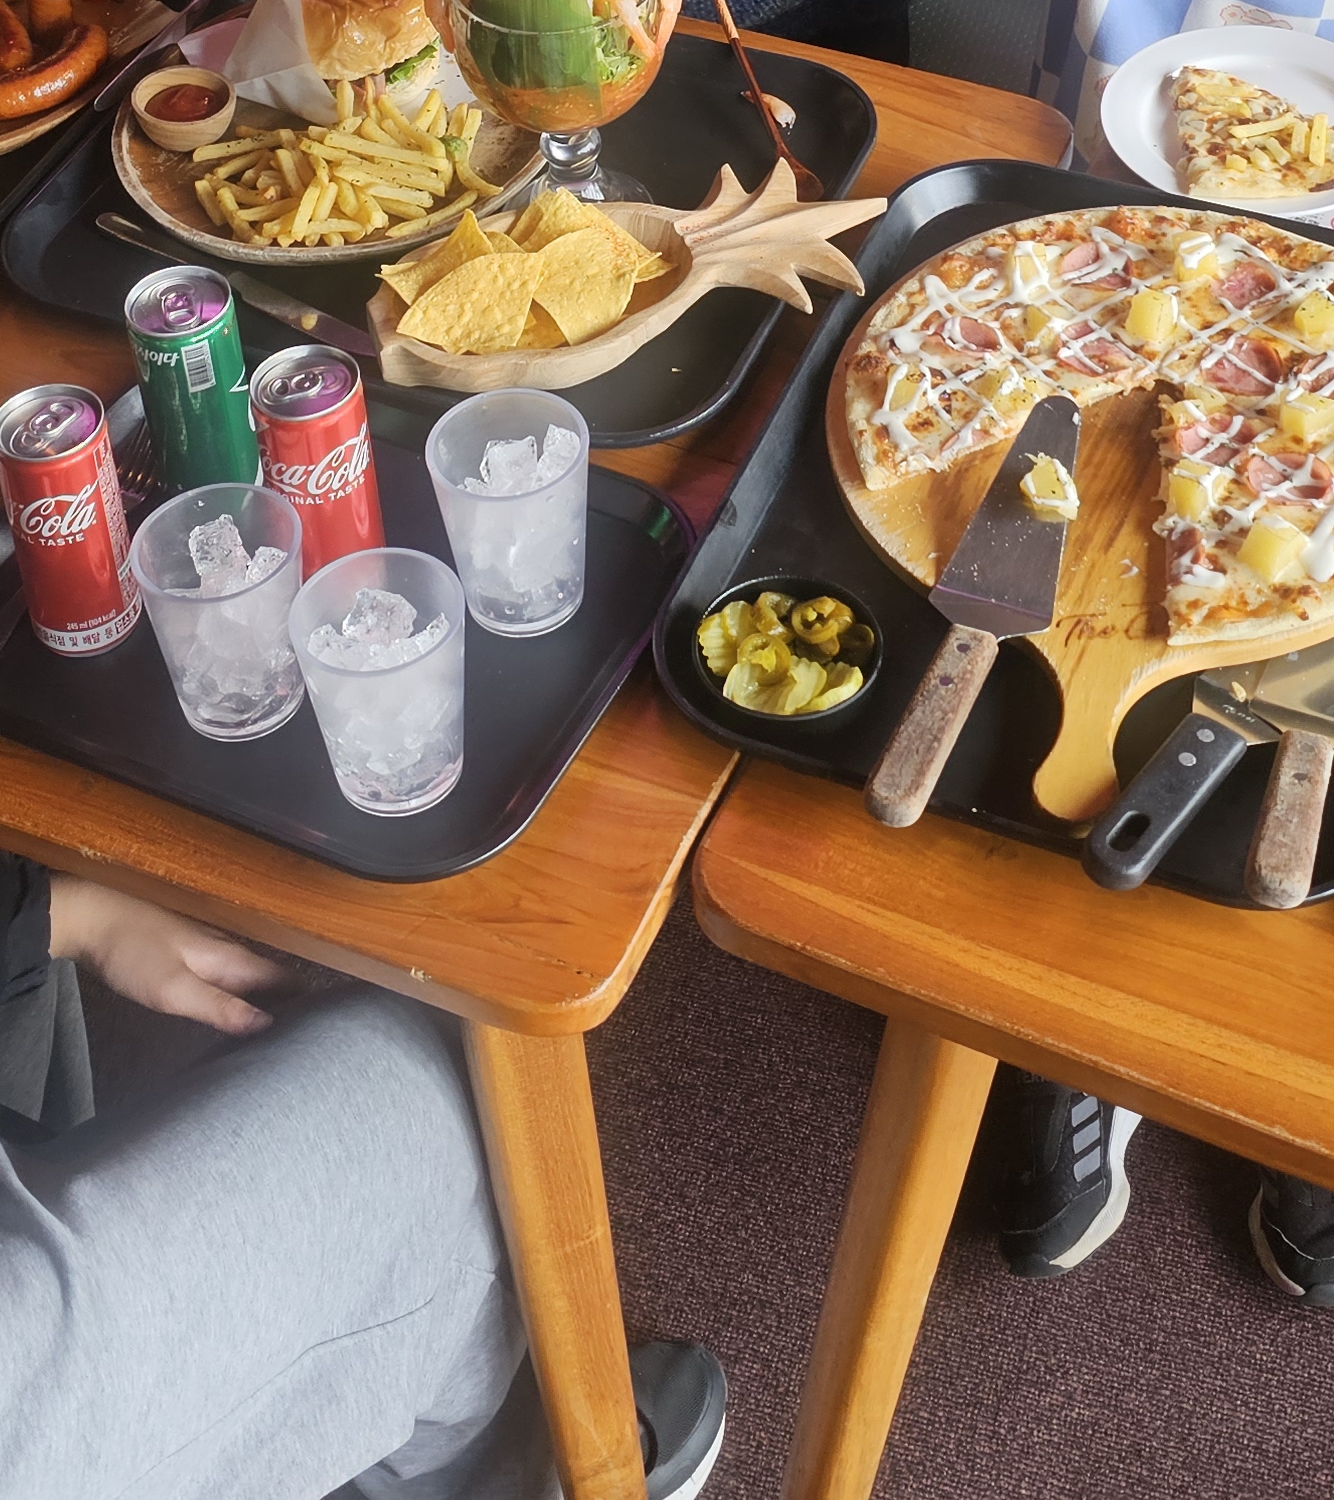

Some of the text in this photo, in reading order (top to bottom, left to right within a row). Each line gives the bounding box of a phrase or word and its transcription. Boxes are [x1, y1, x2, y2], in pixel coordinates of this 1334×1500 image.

[328, 473, 365, 501] TASTE
[38, 532, 85, 547] TASTE
[82, 632, 101, 645] 배달
